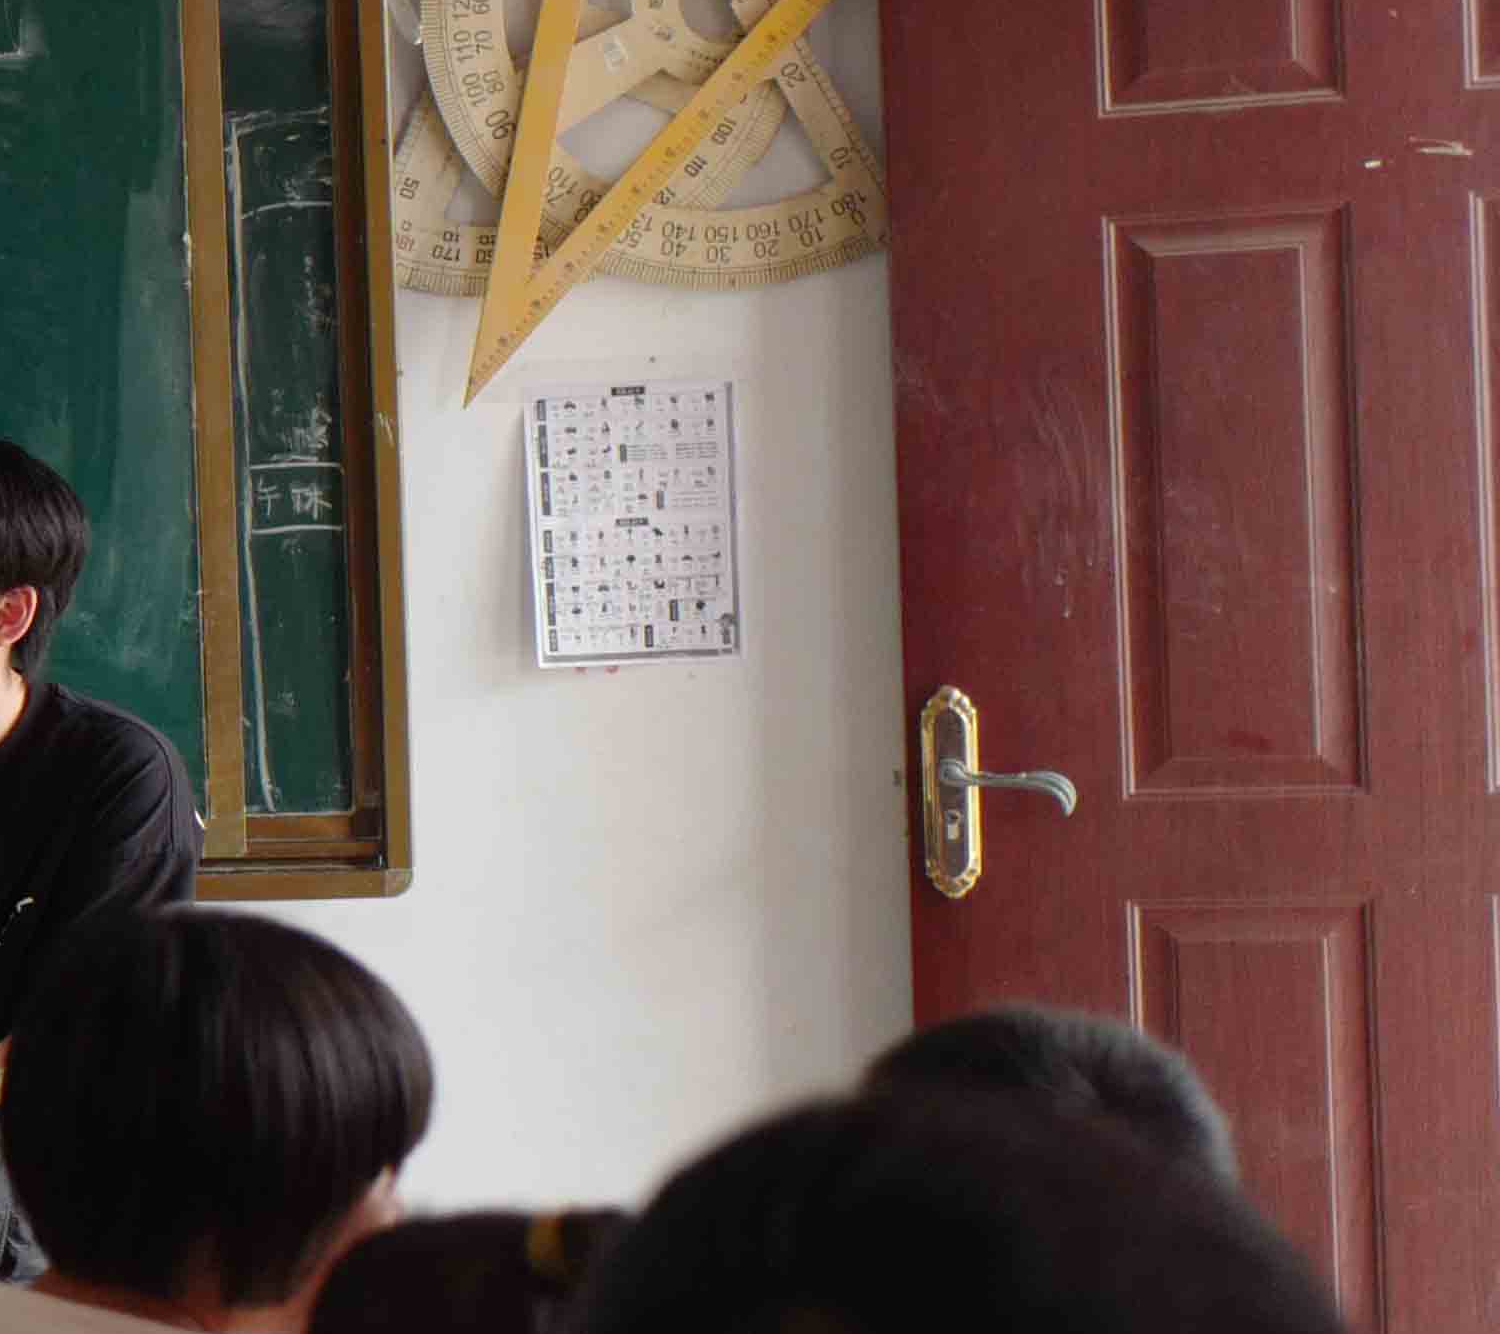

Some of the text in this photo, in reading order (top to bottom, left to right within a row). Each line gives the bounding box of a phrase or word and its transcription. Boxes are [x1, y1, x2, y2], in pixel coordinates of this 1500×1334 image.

[453, 30, 474, 64] 110
[474, 30, 493, 55] 70
[461, 73, 488, 108] 100
[485, 109, 516, 141] 90
[658, 186, 677, 205] 12
[662, 221, 696, 241] 140
[704, 225, 739, 244] 150
[746, 220, 781, 240] 160
[788, 208, 824, 228] 170
[831, 190, 867, 216] 180
[661, 240, 688, 257] 40
[707, 245, 732, 263] 30
[754, 239, 779, 258] 20
[800, 227, 824, 248] 10
